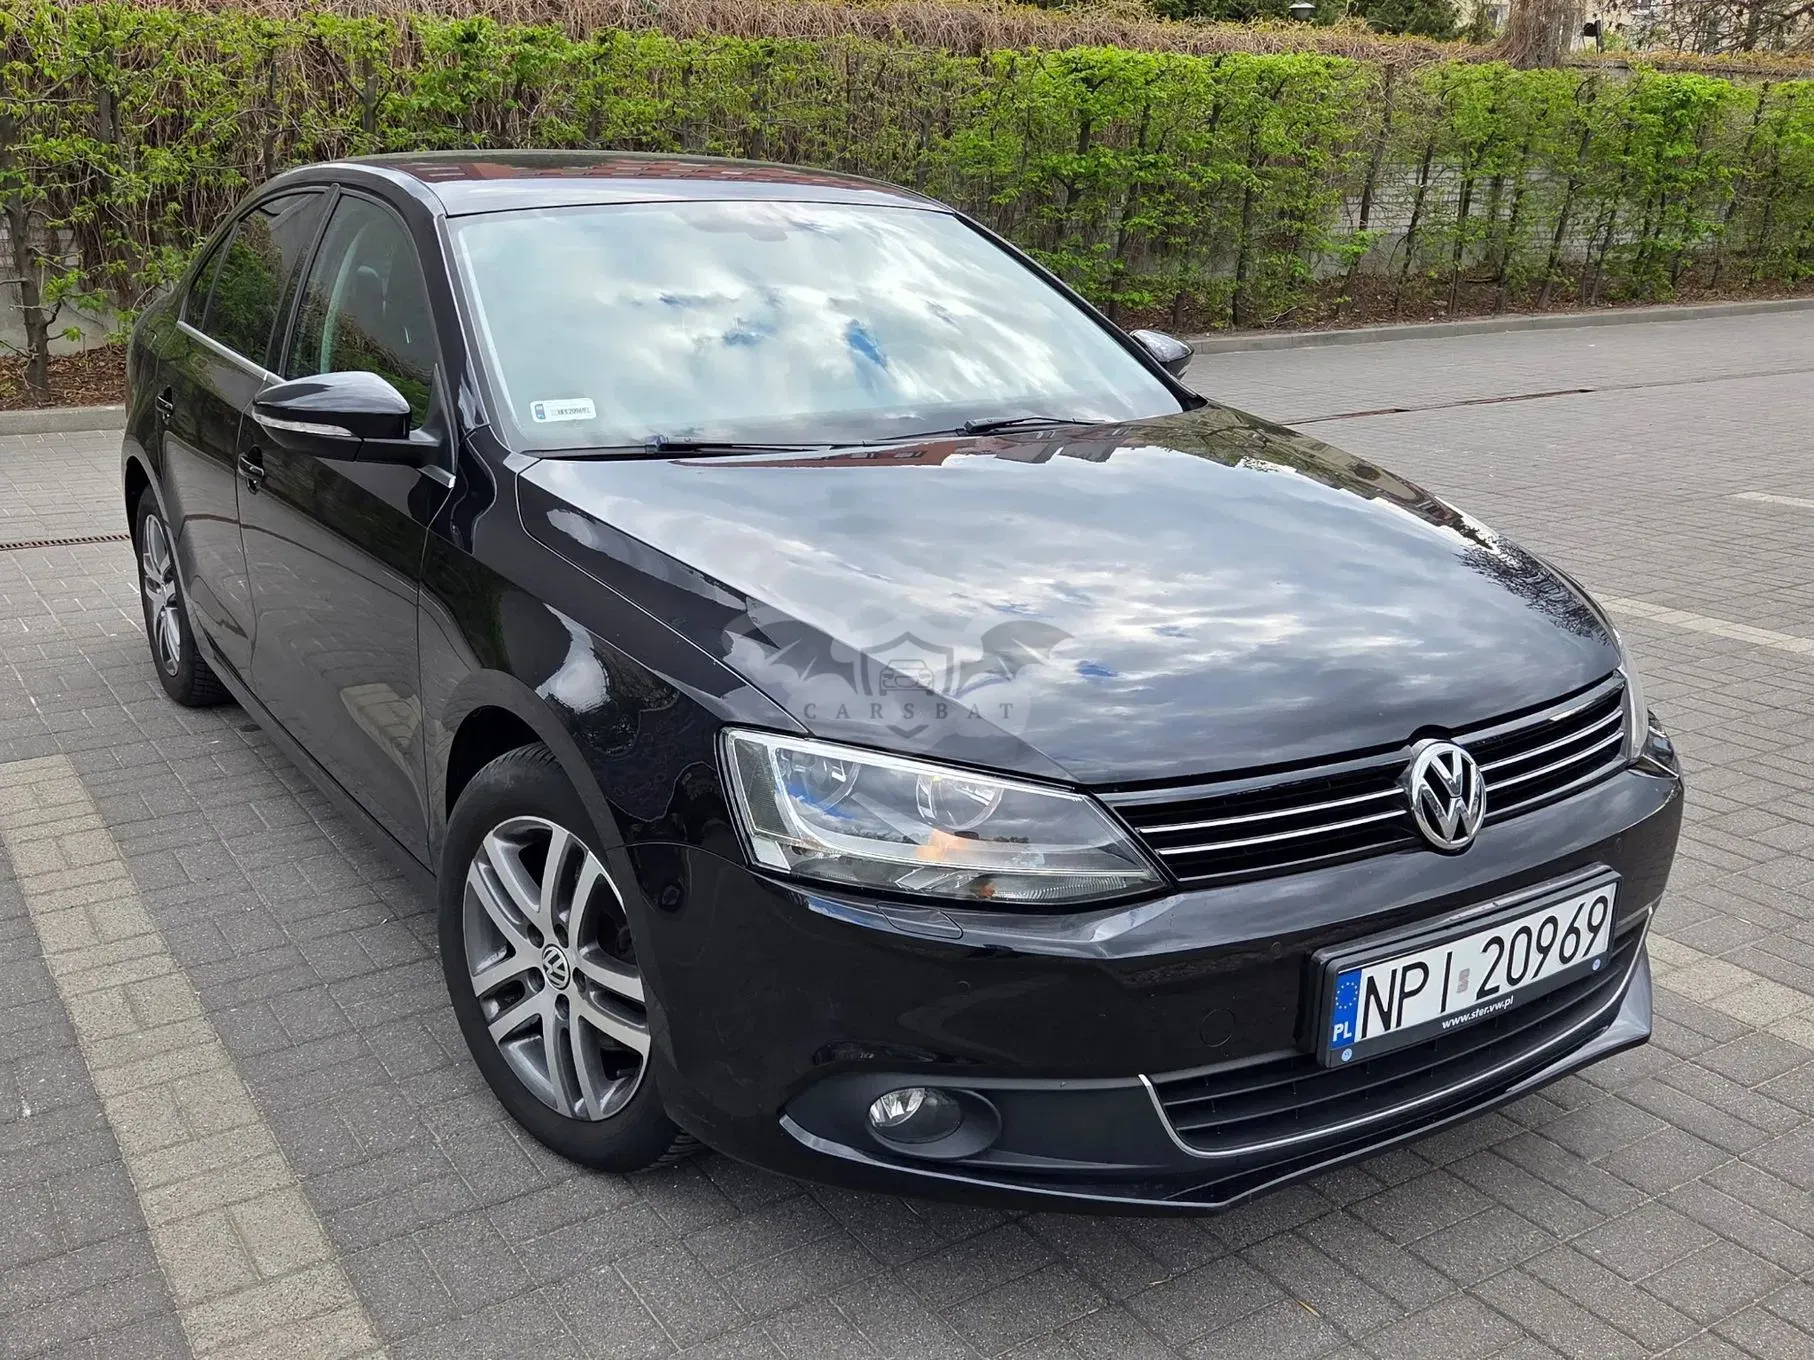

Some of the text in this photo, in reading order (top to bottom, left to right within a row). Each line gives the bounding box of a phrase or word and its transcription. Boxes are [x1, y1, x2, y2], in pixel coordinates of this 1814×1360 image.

[1412, 743, 1486, 850] VW
[1361, 895, 1609, 1039] NPI 20969
[1332, 1021, 1353, 1042] PL
